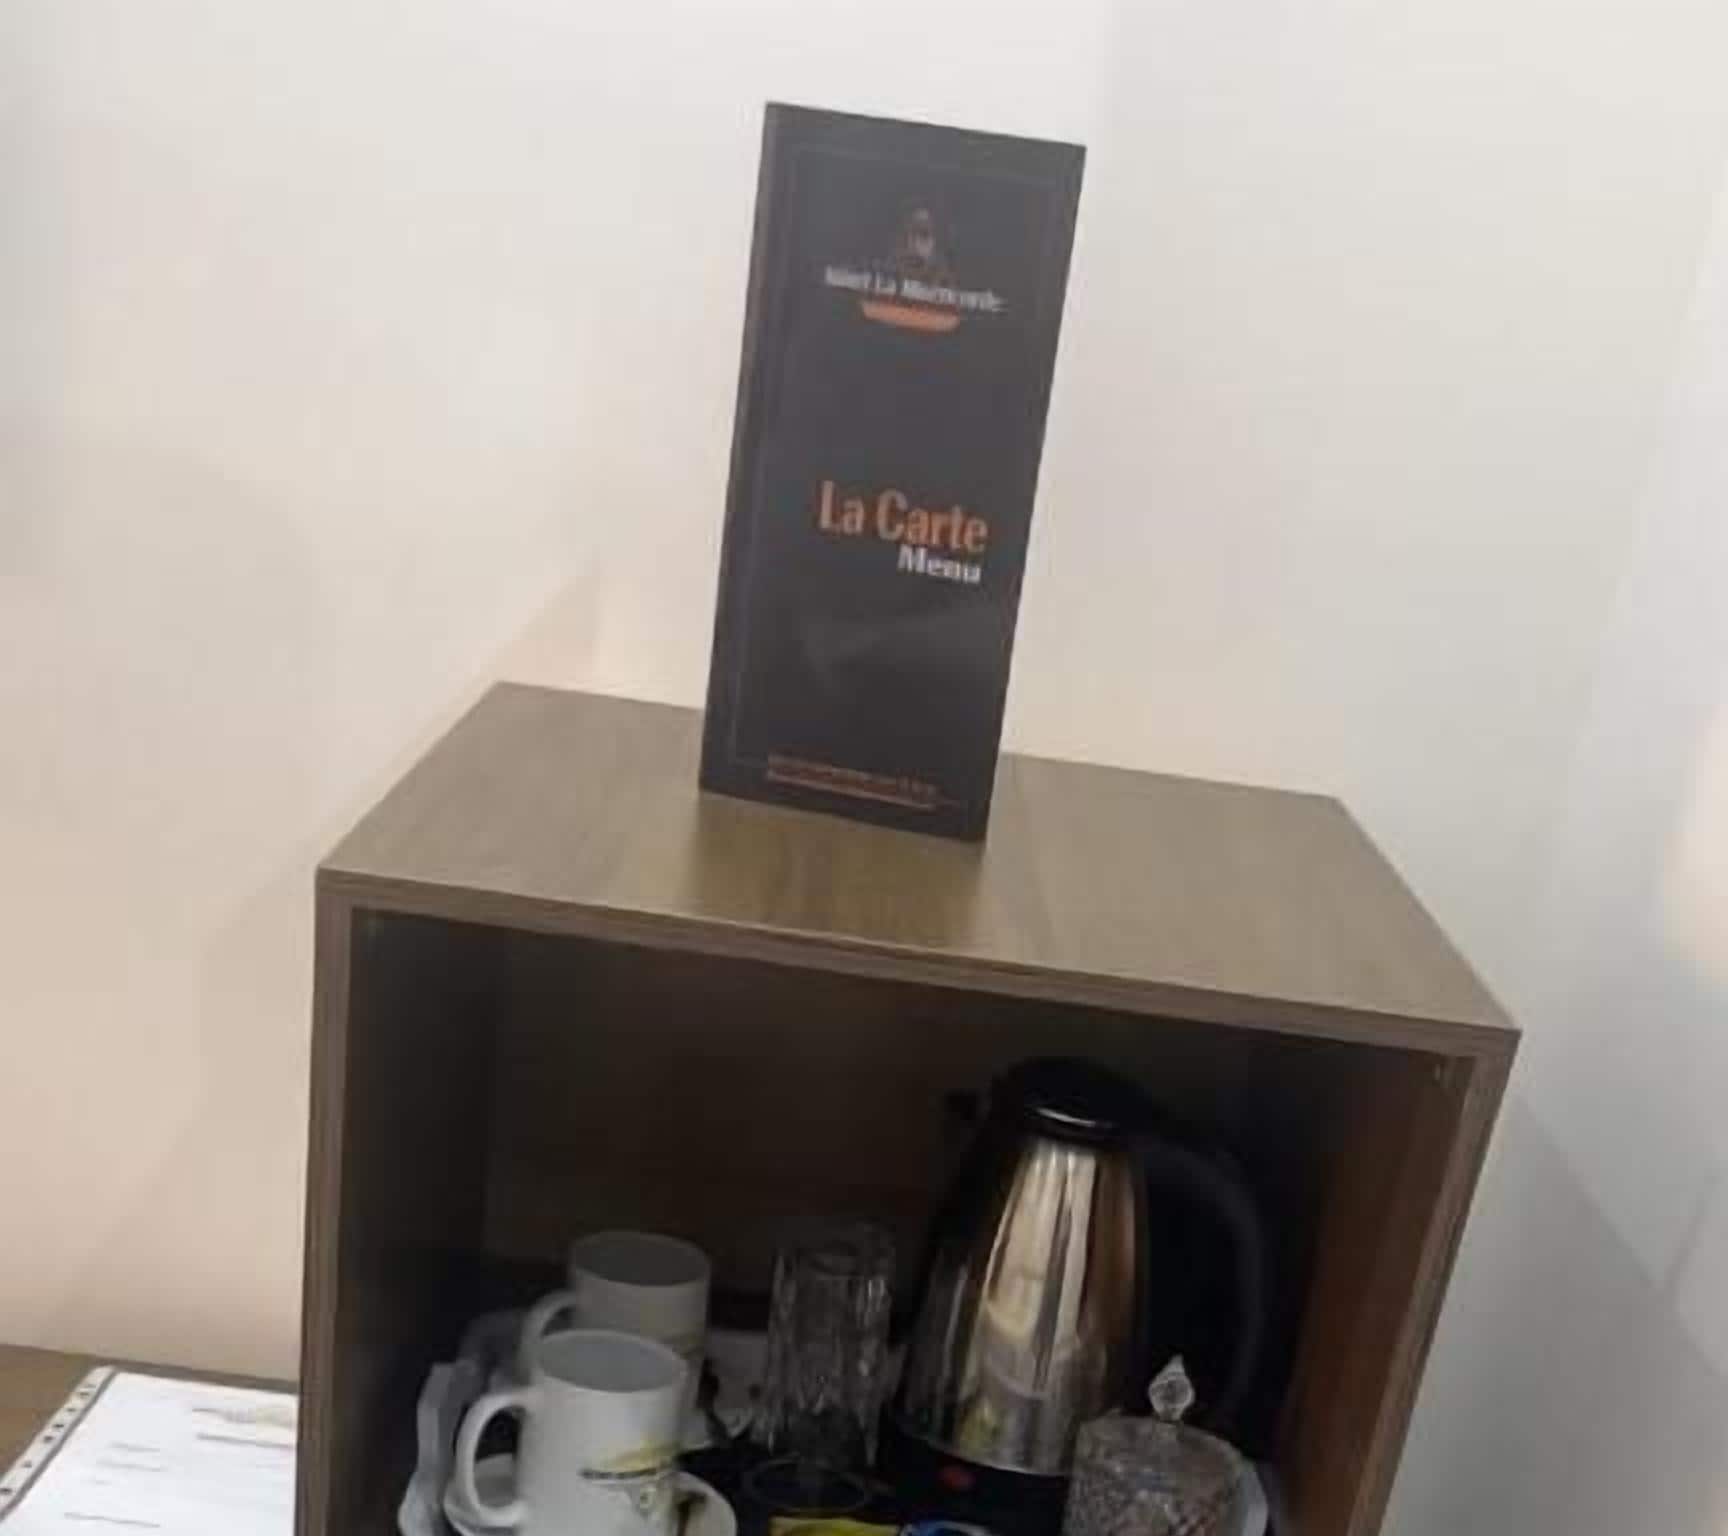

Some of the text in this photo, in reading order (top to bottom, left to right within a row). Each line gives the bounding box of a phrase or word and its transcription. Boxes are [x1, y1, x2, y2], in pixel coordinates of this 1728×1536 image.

[818, 479, 989, 553] La Carte
[897, 544, 982, 585] Menu
